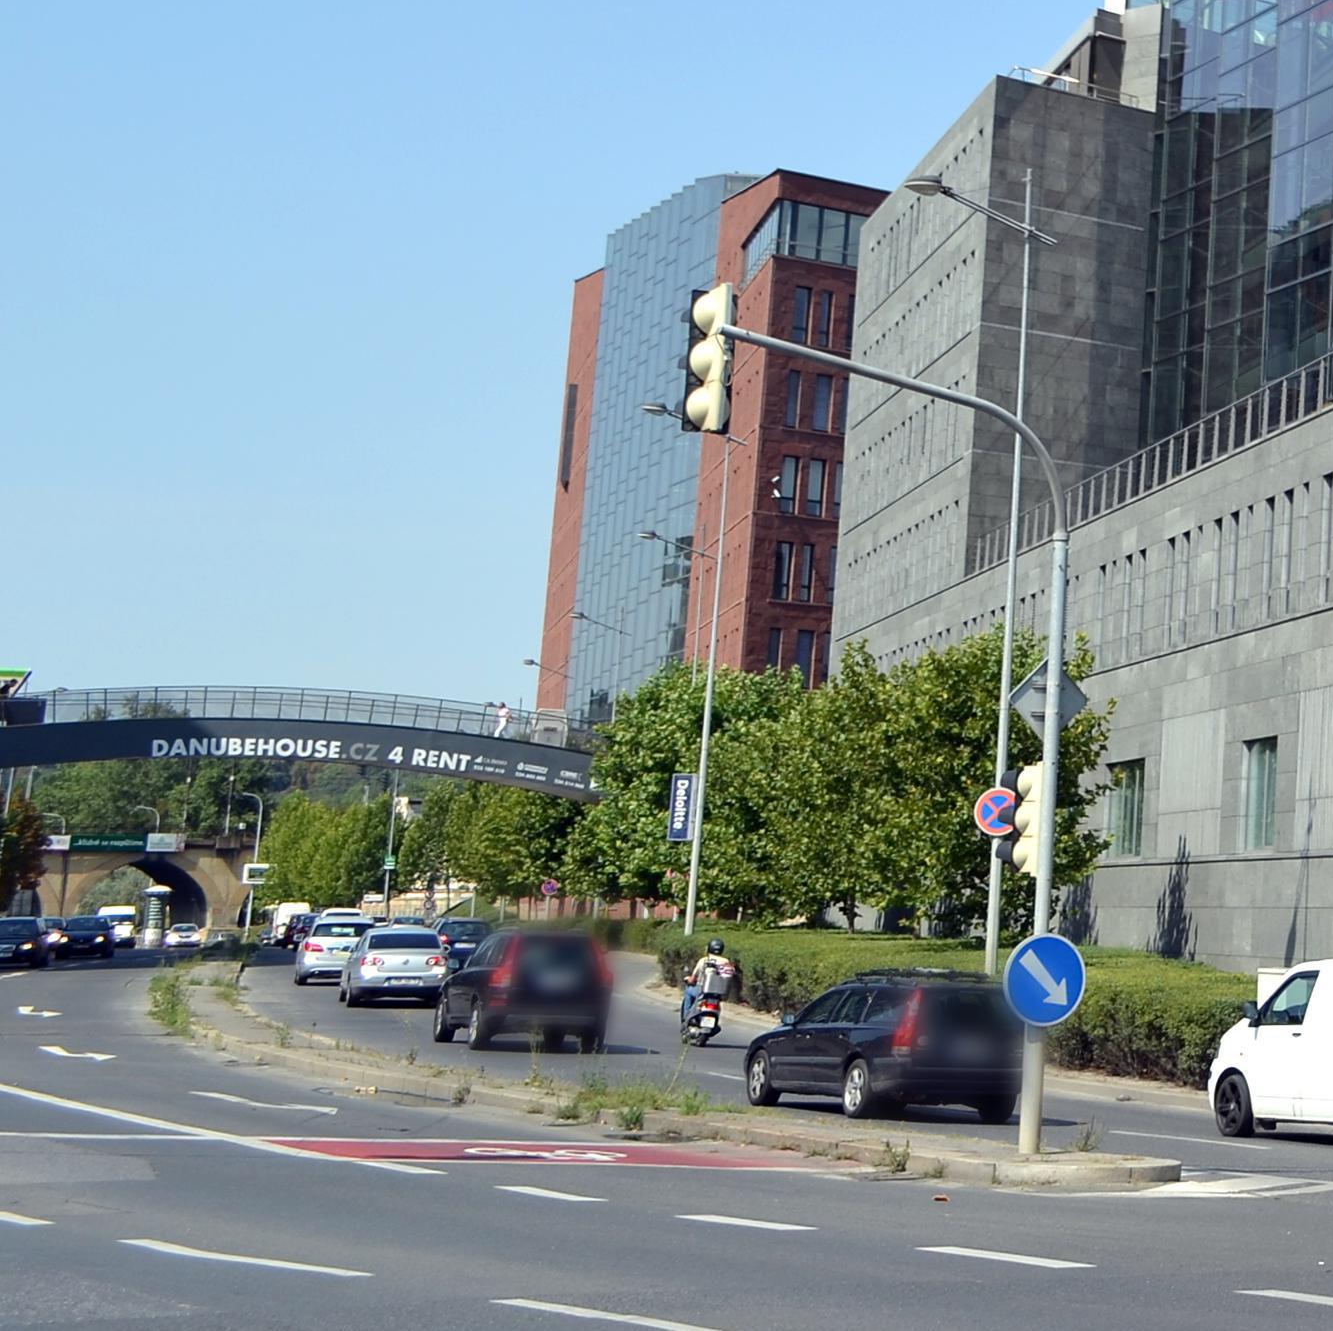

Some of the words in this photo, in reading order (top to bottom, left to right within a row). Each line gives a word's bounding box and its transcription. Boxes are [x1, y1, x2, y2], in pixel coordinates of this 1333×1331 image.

[151, 737, 380, 761] DANUBEHOUSE.CZ
[388, 746, 403, 764] 4
[411, 748, 471, 772] RENT
